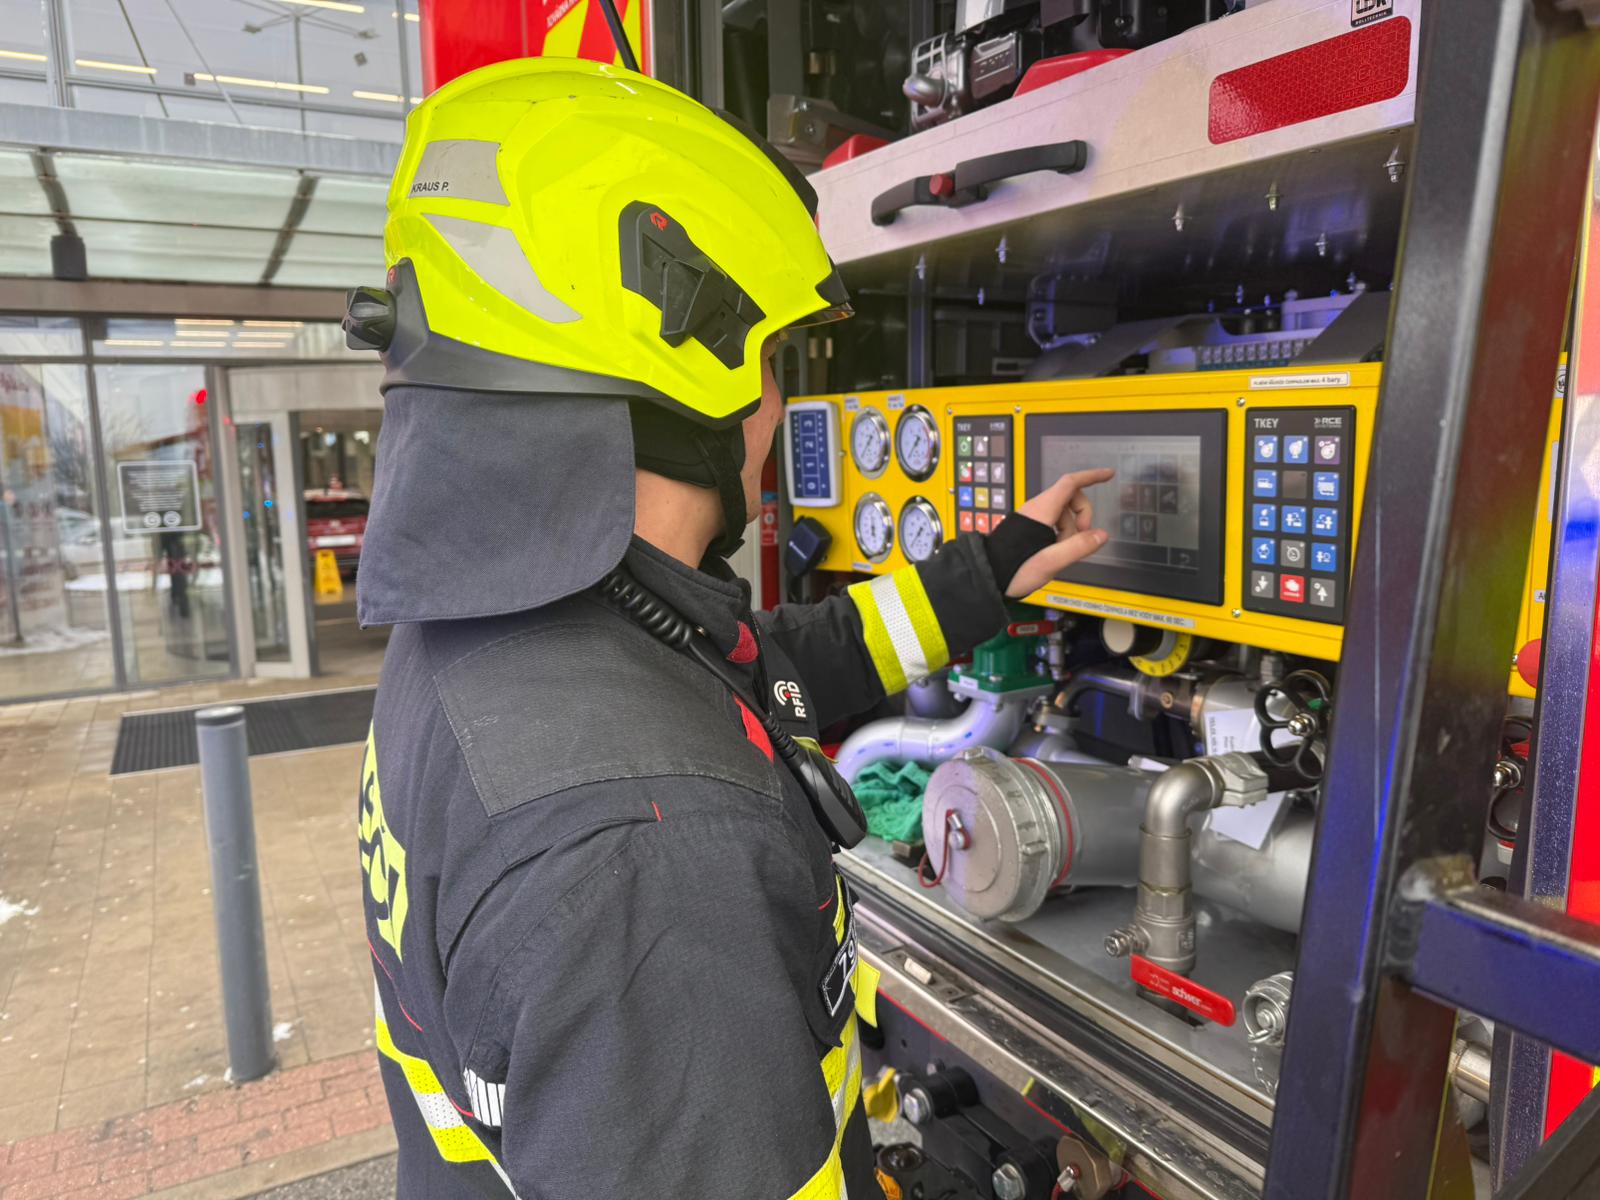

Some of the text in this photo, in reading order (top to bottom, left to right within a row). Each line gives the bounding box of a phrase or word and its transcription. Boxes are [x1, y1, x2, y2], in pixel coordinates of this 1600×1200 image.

[411, 181, 449, 193] KRAUS P.
[1254, 418, 1279, 428] TKEY
[786, 681, 807, 718] RFID
